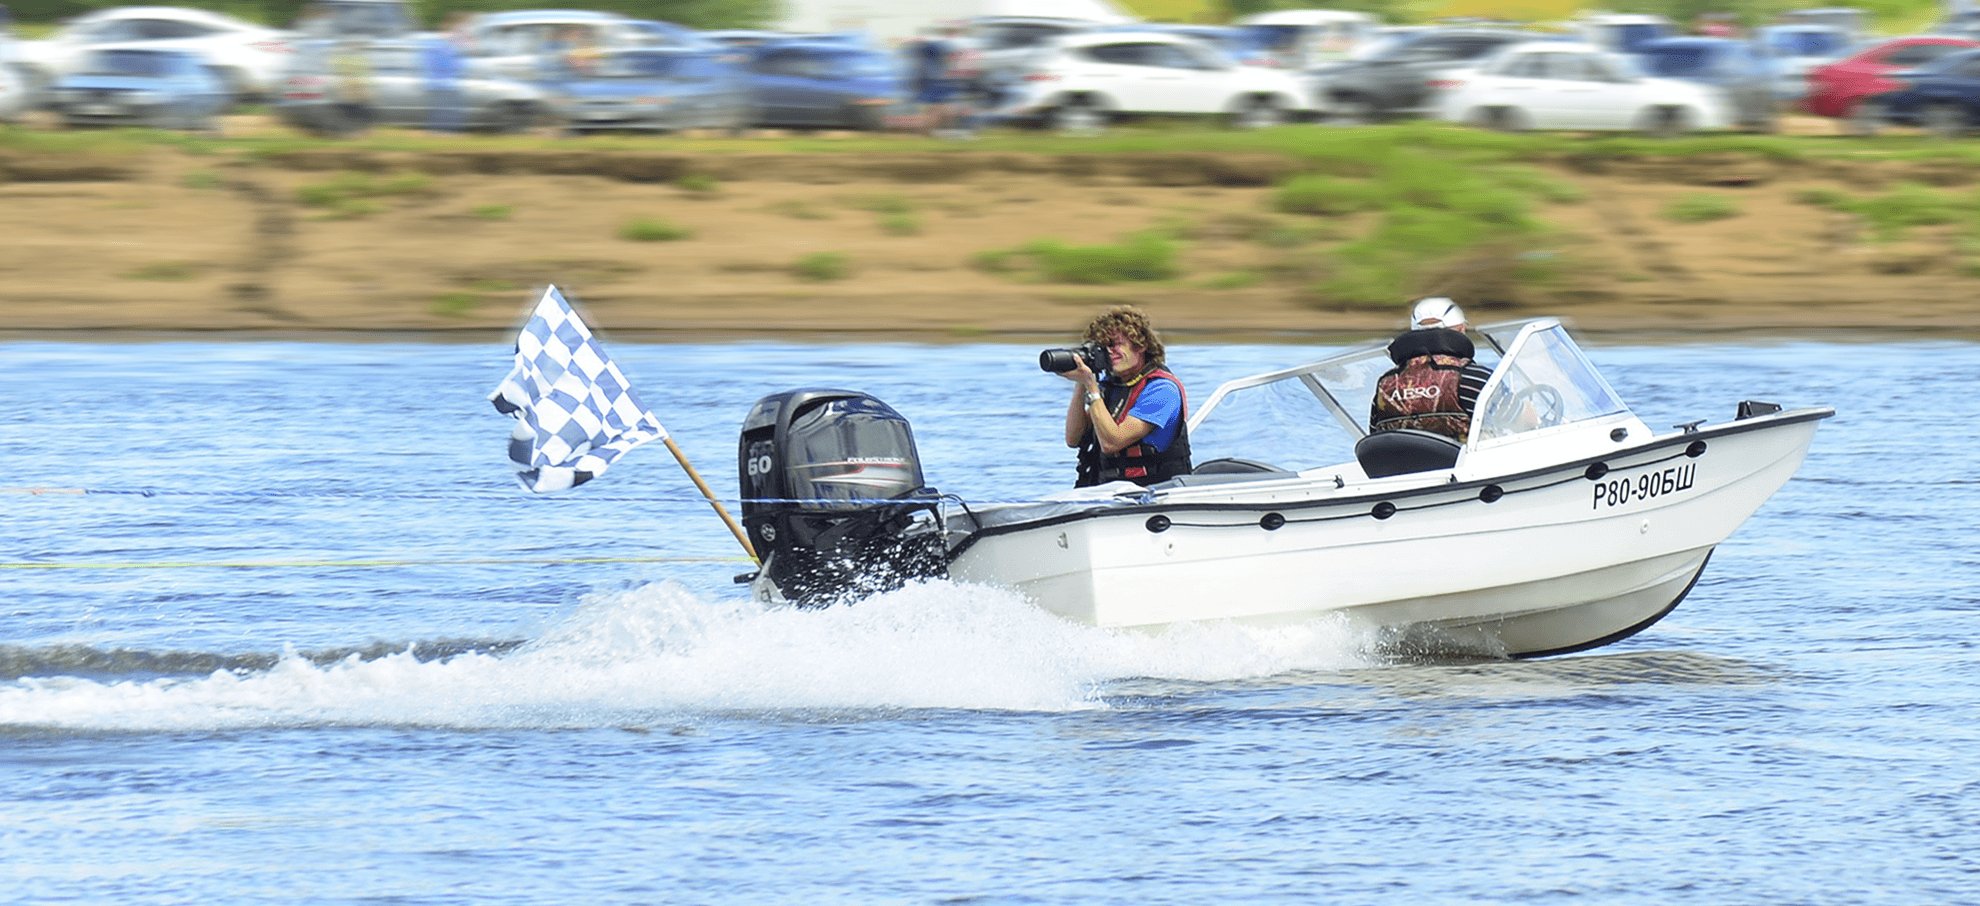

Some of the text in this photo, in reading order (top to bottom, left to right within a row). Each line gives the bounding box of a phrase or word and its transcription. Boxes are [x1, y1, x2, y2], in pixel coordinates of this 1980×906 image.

[1391, 385, 1440, 400] AERO
[748, 455, 771, 476] 60
[1593, 463, 1696, 510] Р80-90БШ
